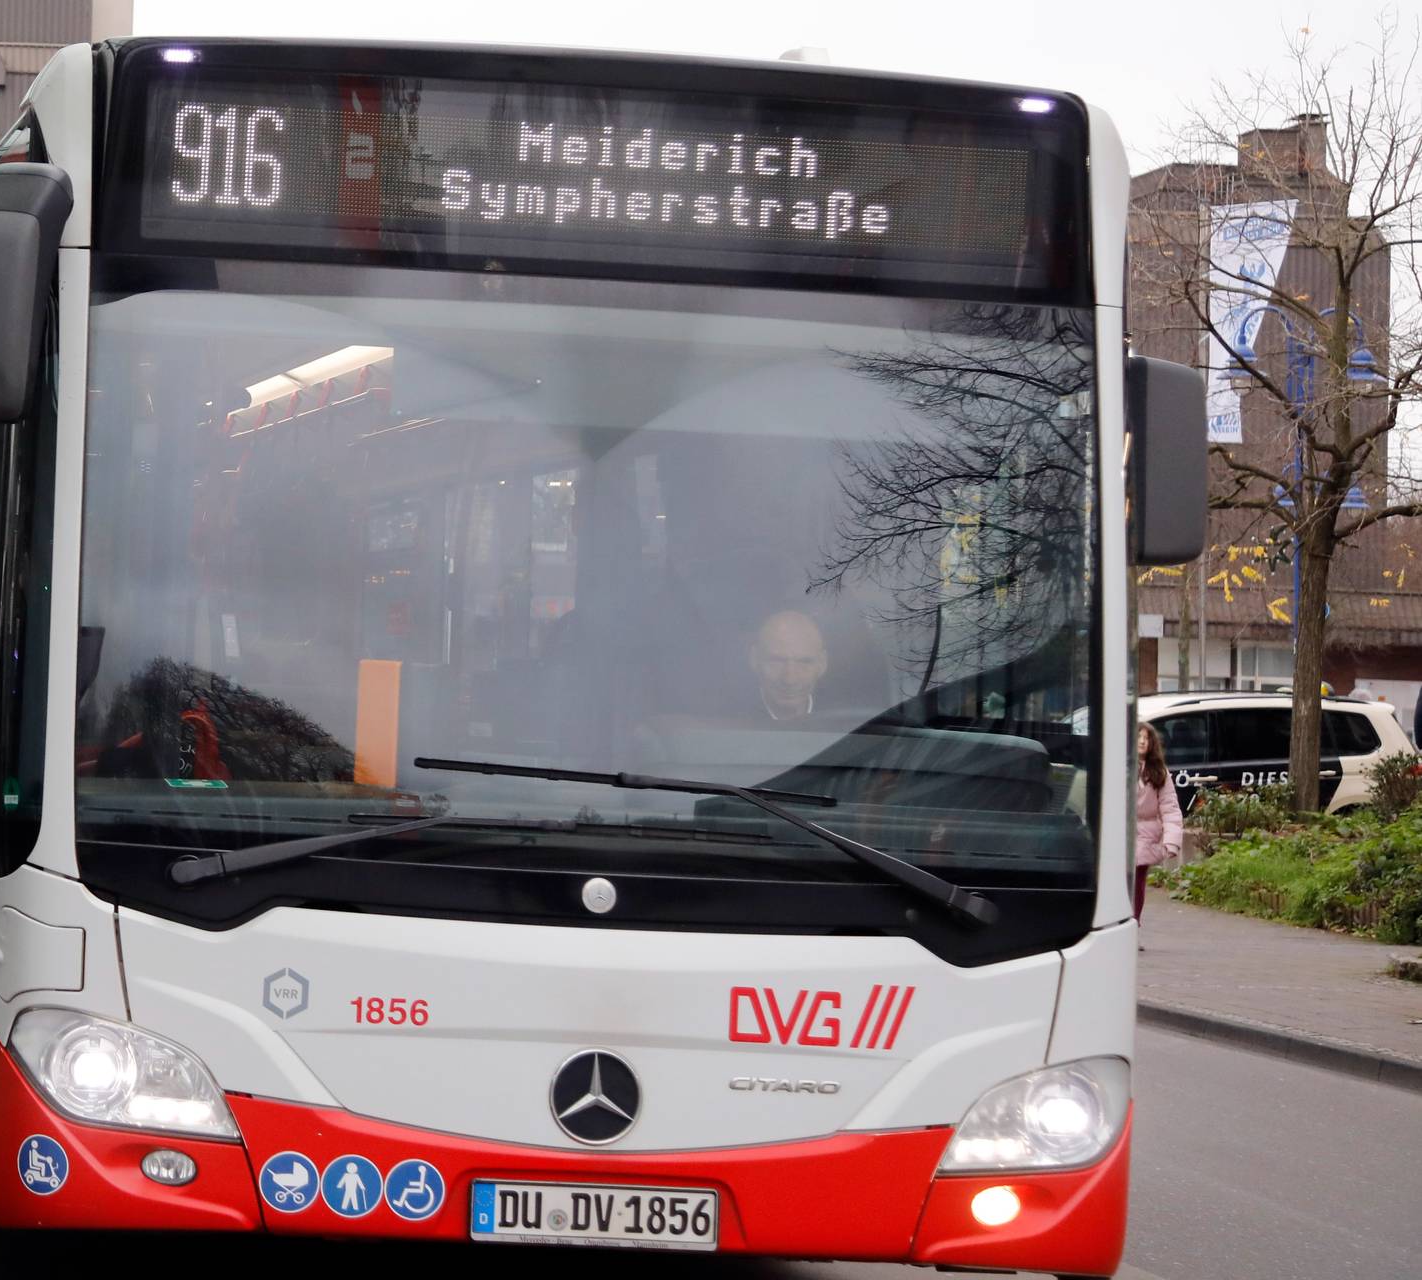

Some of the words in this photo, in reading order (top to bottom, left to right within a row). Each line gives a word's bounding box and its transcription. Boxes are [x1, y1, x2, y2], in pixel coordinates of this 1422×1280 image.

[172, 104, 284, 206] 916
[518, 120, 819, 179] Meiderich
[440, 167, 890, 240] Sympherstraße
[1241, 771, 1289, 787] DIES
[274, 988, 299, 1000] VRR
[350, 997, 429, 1026] 1856
[728, 1076, 842, 1095] CITARO
[479, 1212, 488, 1225] D
[498, 1190, 543, 1230] DU
[570, 1192, 615, 1232] DV
[624, 1195, 712, 1237] 1856
